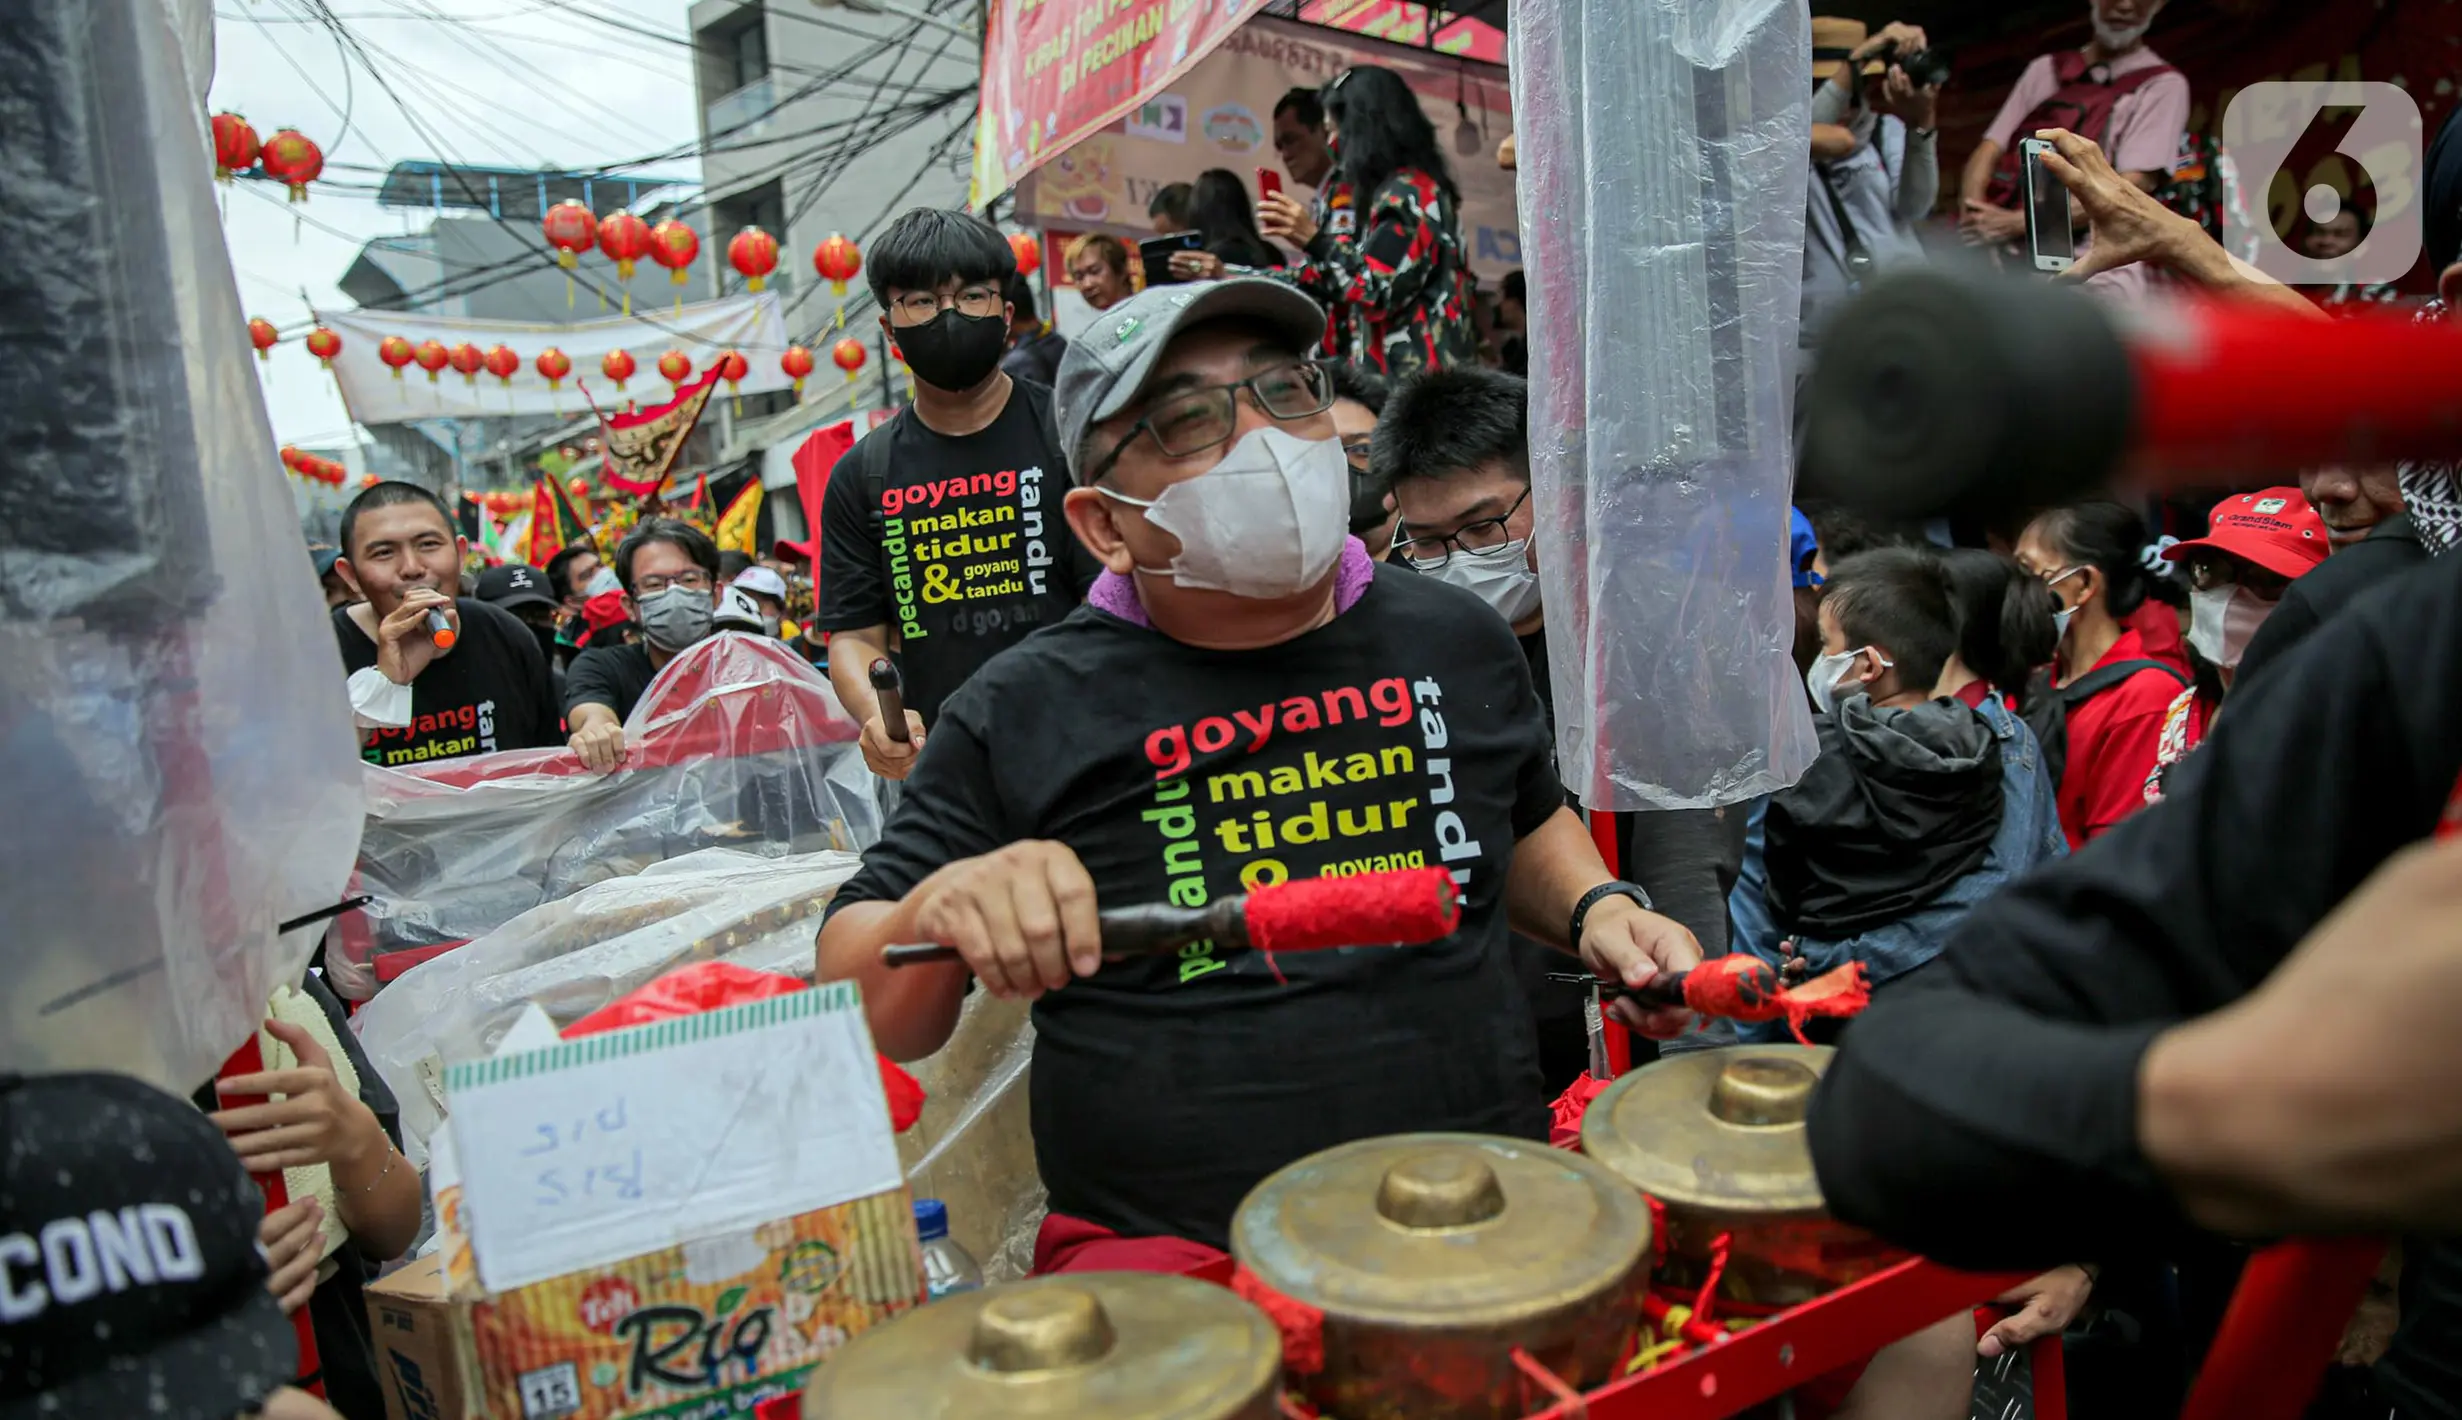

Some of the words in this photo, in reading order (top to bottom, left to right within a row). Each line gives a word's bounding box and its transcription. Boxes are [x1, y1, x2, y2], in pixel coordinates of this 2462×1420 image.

[1080, 5, 1165, 81] PECINAN
[881, 470, 1017, 516] goyang
[911, 505, 1015, 535] makan
[1019, 466, 1053, 595] tandu
[913, 531, 1017, 562] tidur
[964, 559, 1020, 580] goyang
[882, 518, 928, 640] pecandu
[922, 564, 964, 604] &
[965, 580, 1024, 599] tandu
[973, 603, 1039, 636] goyan
[387, 736, 476, 765] makan
[477, 700, 497, 754] tan
[1144, 676, 1413, 780] goyang
[1208, 745, 1415, 803] makan
[1214, 797, 1418, 853] tidur
[1142, 775, 1226, 983] peandu
[615, 1300, 775, 1397] Rio
[533, 1381, 571, 1411] 15
